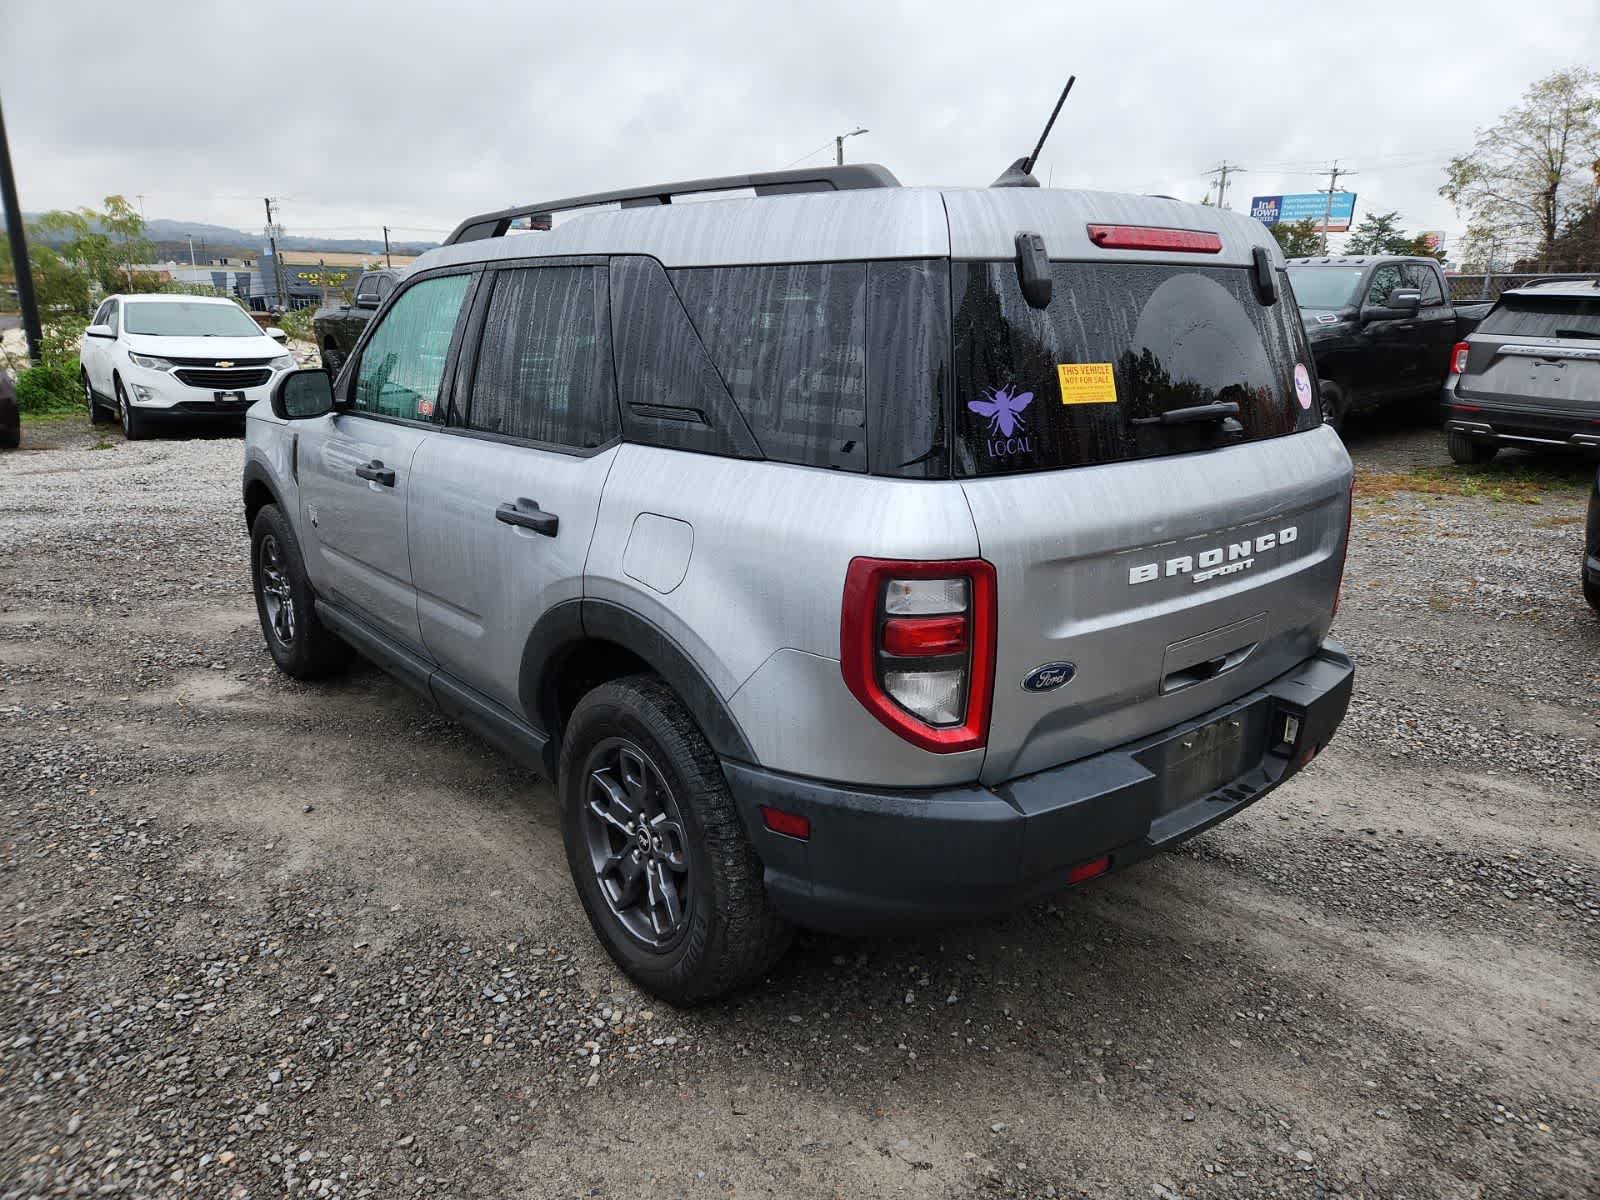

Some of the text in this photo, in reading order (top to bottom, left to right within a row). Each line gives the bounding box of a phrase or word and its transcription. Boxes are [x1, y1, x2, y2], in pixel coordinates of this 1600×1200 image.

[1258, 201, 1268, 209] In
[1253, 208, 1278, 217] Town
[1062, 366, 1110, 376] THIS VEHICLE
[1065, 375, 1110, 385] NOT FOR SALE
[987, 437, 1033, 457] LOCAL
[1129, 526, 1298, 584] BRONCO
[1192, 558, 1255, 583] SPORT
[1036, 670, 1067, 689] Ford
